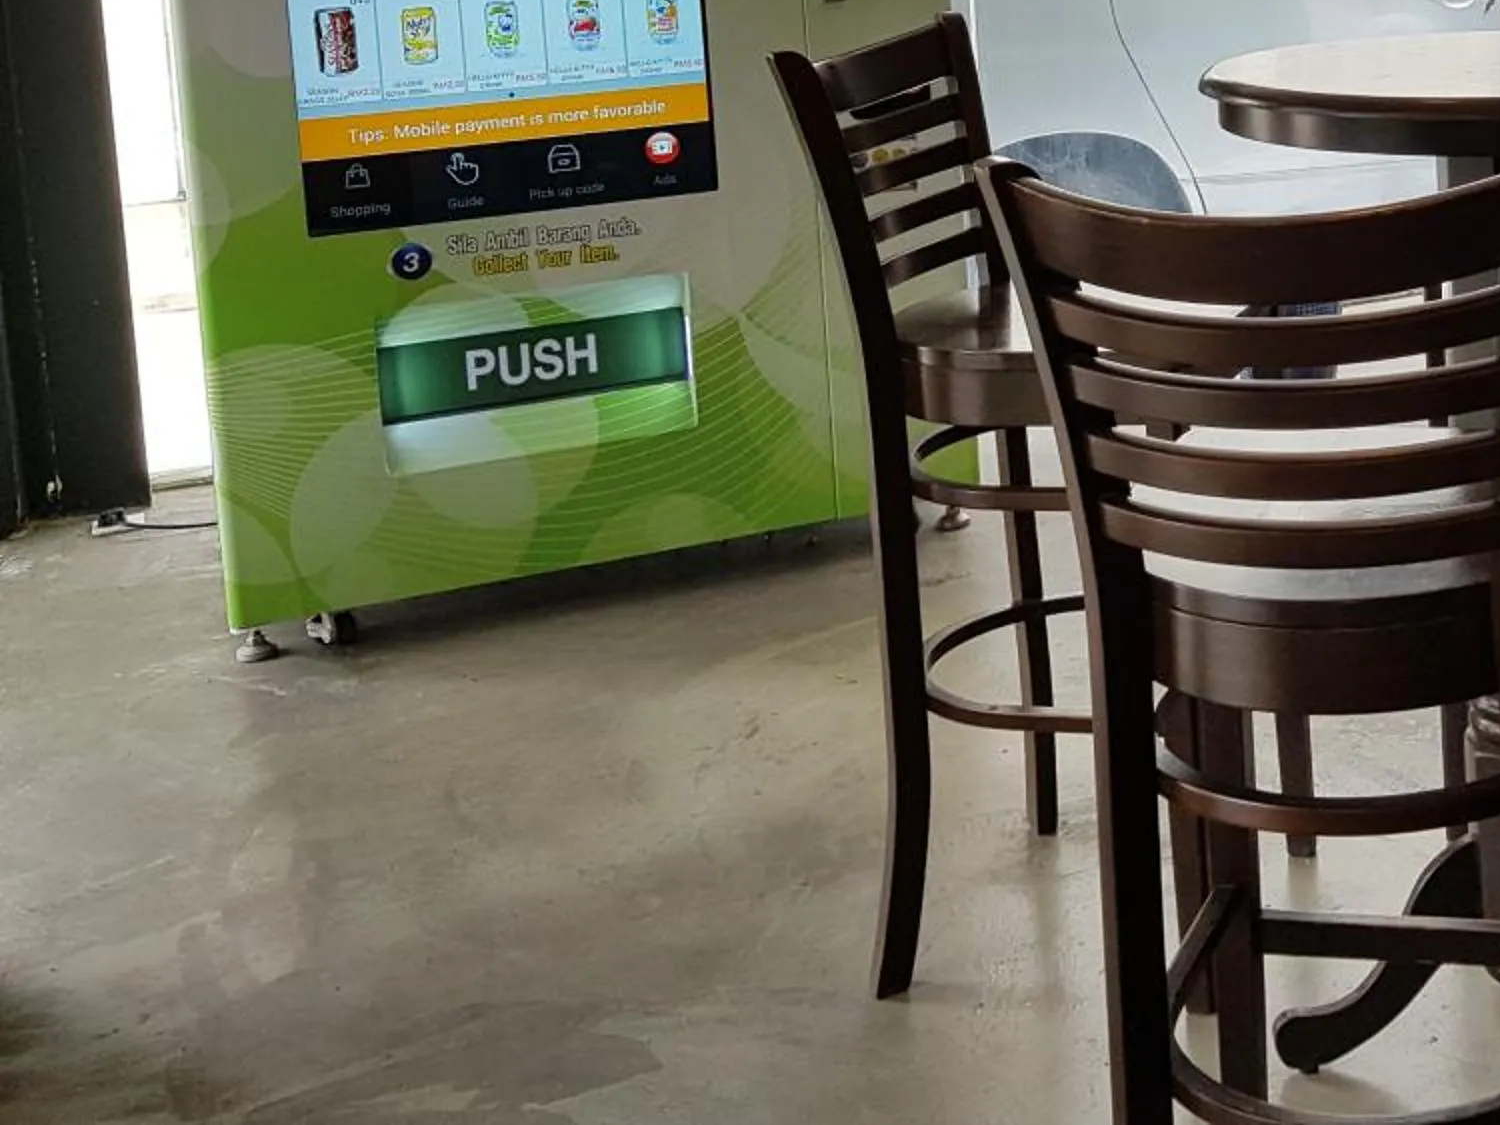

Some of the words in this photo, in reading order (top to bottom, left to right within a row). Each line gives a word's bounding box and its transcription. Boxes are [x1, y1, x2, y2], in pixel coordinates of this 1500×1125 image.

[393, 119, 450, 139] Mobile
[455, 115, 526, 136] payment
[530, 114, 543, 125] is
[548, 108, 589, 123] more
[594, 101, 666, 120] favorable
[447, 195, 486, 210] Guide
[529, 187, 555, 201] Pick
[557, 187, 574, 199] up
[576, 182, 605, 195] code
[330, 202, 392, 219] Shopping
[447, 233, 478, 255] Sila
[484, 226, 530, 252] Ambil
[536, 223, 591, 246] Barang
[473, 251, 530, 275] Collect
[536, 248, 573, 269] Your
[465, 332, 600, 392] PUSH
